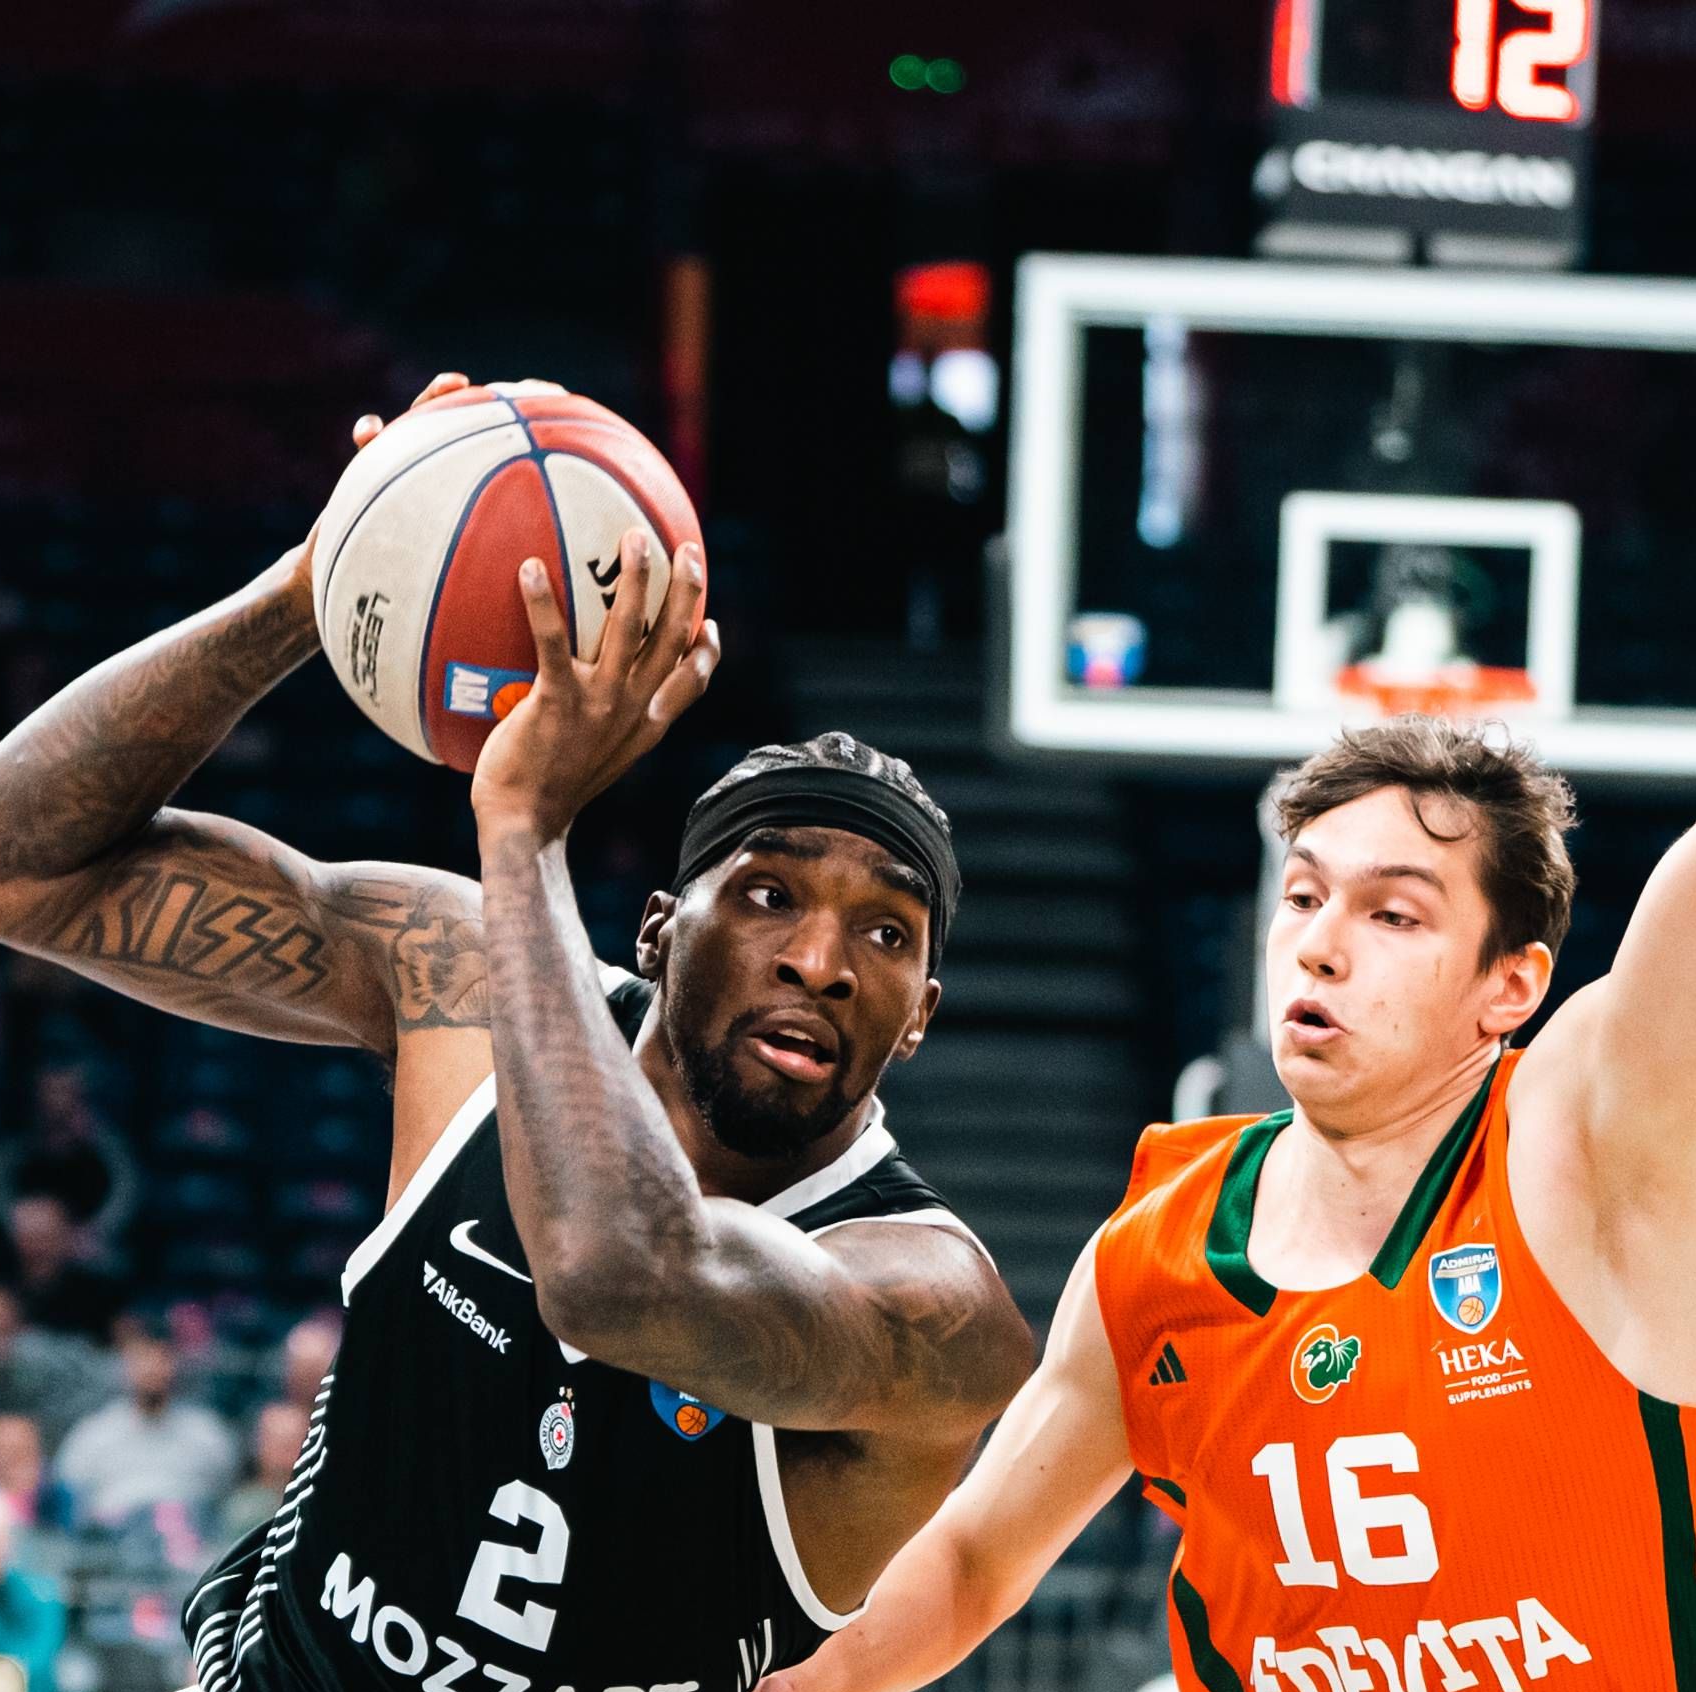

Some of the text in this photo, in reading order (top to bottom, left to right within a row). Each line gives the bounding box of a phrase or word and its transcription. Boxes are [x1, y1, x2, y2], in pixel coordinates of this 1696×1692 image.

[1452, 0, 1593, 120] 12
[1439, 1251, 1496, 1269] ADMIRAL
[427, 1277, 512, 1354] AikBank
[1438, 1338, 1524, 1376] HEKA
[1471, 1372, 1502, 1387] FOOD
[1448, 1379, 1533, 1405] SUPPLEMENTS
[1251, 1432, 1440, 1589] 16
[456, 1480, 570, 1652] 2
